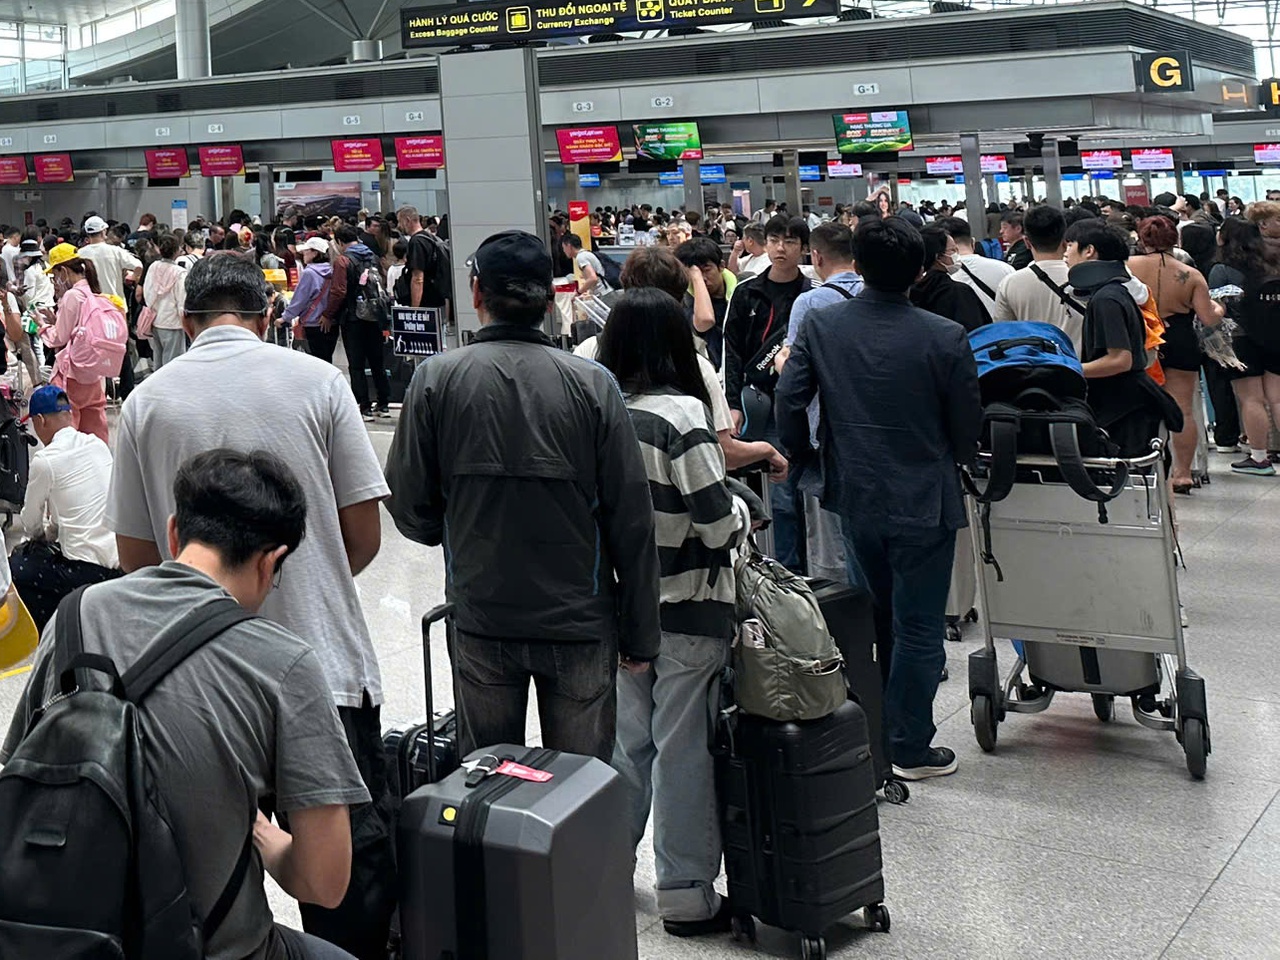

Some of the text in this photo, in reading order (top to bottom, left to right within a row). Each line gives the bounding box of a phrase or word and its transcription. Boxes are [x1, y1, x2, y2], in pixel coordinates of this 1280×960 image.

[535, 0, 627, 18] THU ĐỔI NGOẠI TỆ
[669, 7, 734, 18] Ticket Counter
[409, 17, 434, 28] HÀNH
[436, 14, 448, 25] LÝ
[449, 13, 470, 24] QUÁ
[536, 16, 614, 29] Currency Exchange
[410, 25, 499, 38] Excess Baggage Counter
[1150, 57, 1182, 87] G
[857, 84, 876, 95] G-1
[576, 102, 592, 112] G-3
[654, 97, 671, 108] G-2
[408, 112, 422, 121] G-4
[756, 344, 781, 371] Reebok
